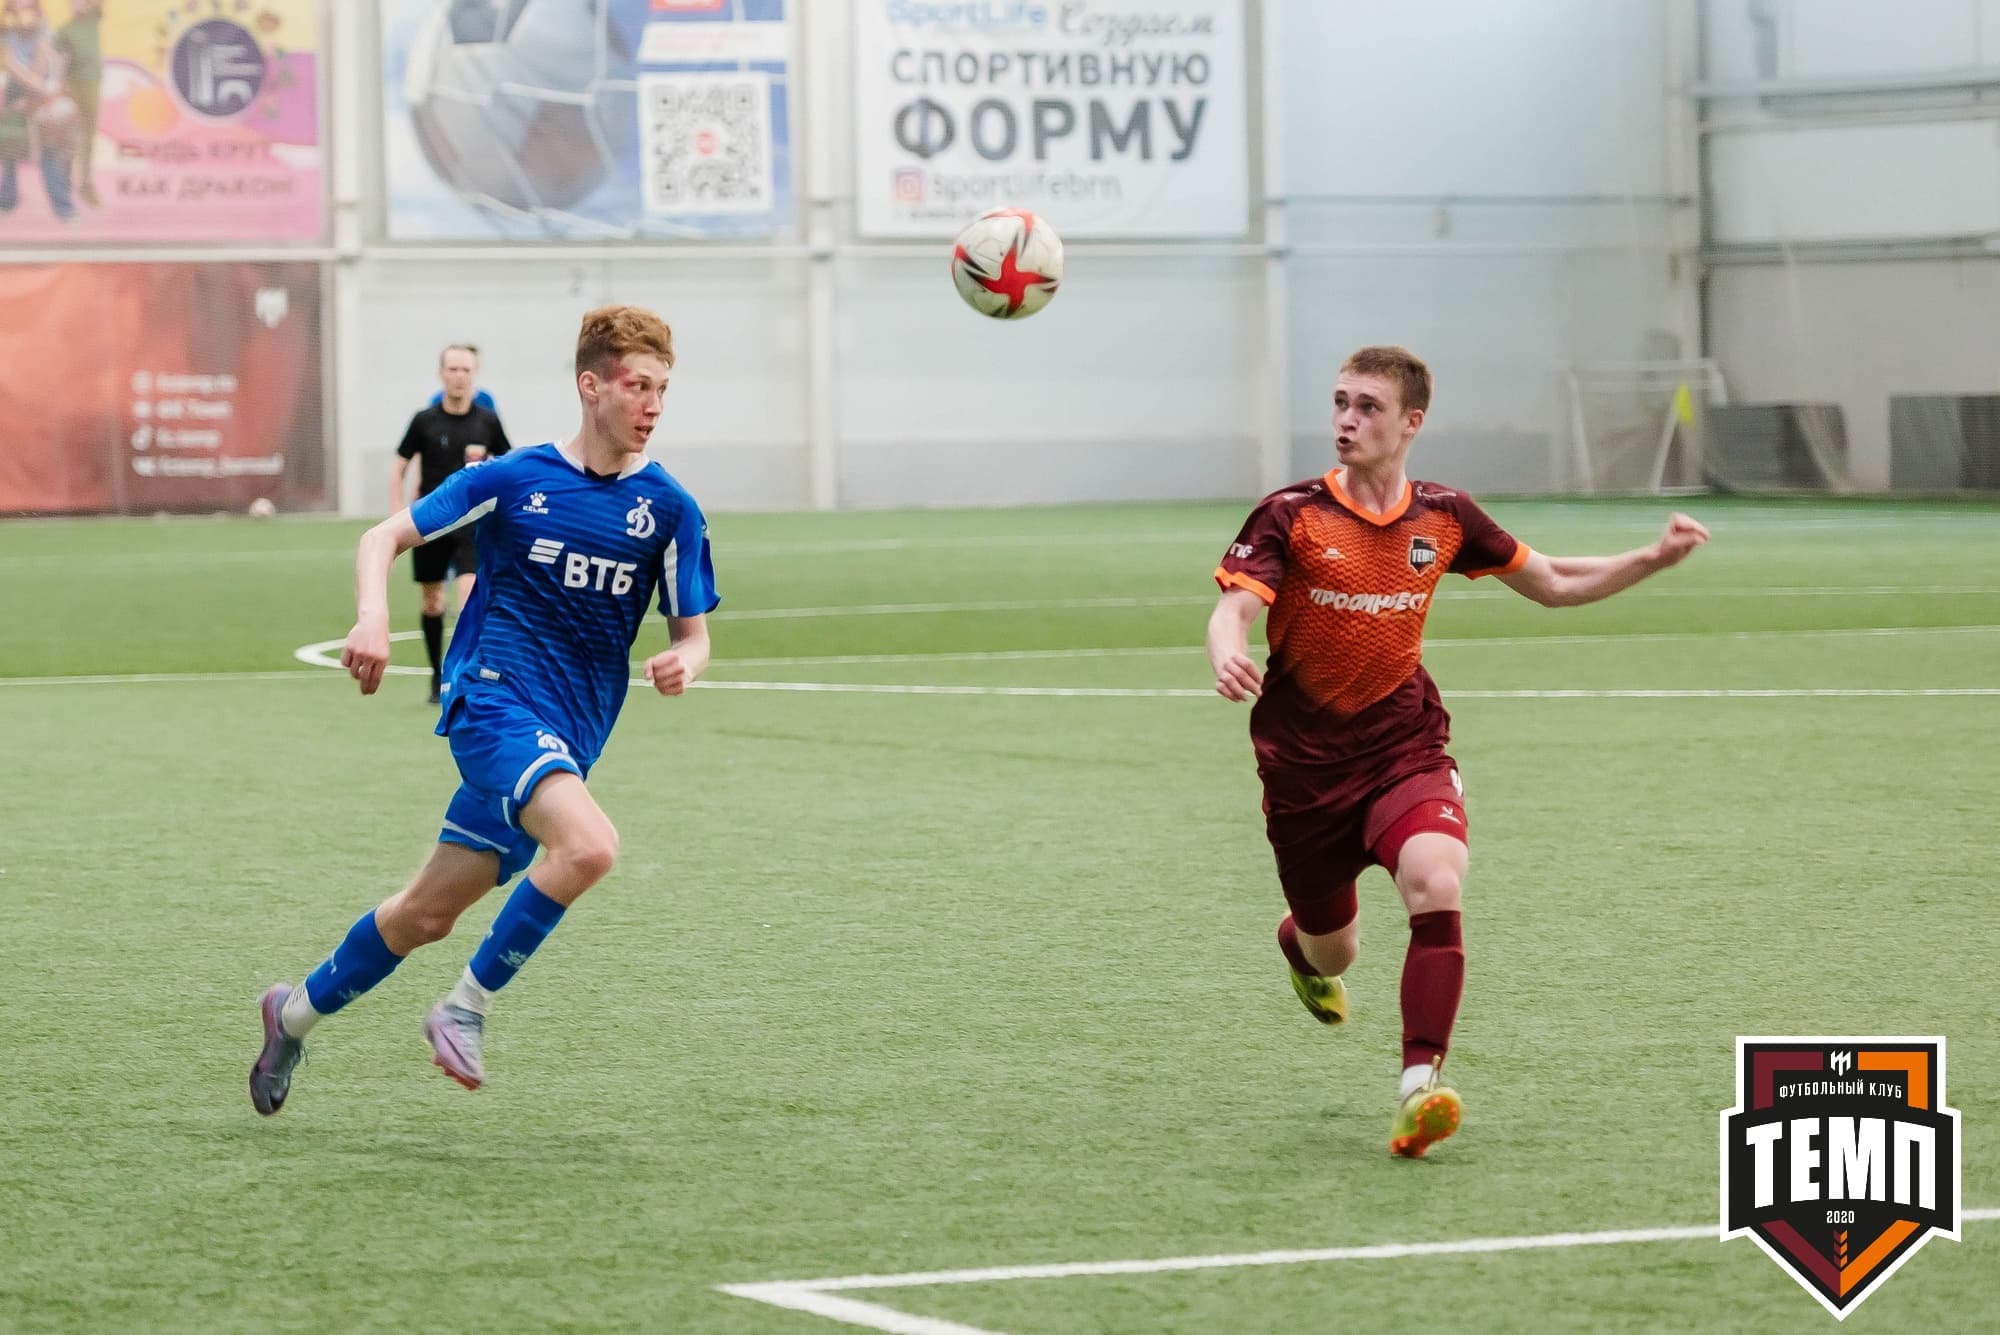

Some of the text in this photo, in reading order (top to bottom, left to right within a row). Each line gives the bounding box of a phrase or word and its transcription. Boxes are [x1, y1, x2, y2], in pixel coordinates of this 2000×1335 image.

[892, 50, 1211, 86] СПОРТИВНУЮ
[894, 97, 1206, 161] ФОРМУ
[563, 552, 637, 595] ВТБ
